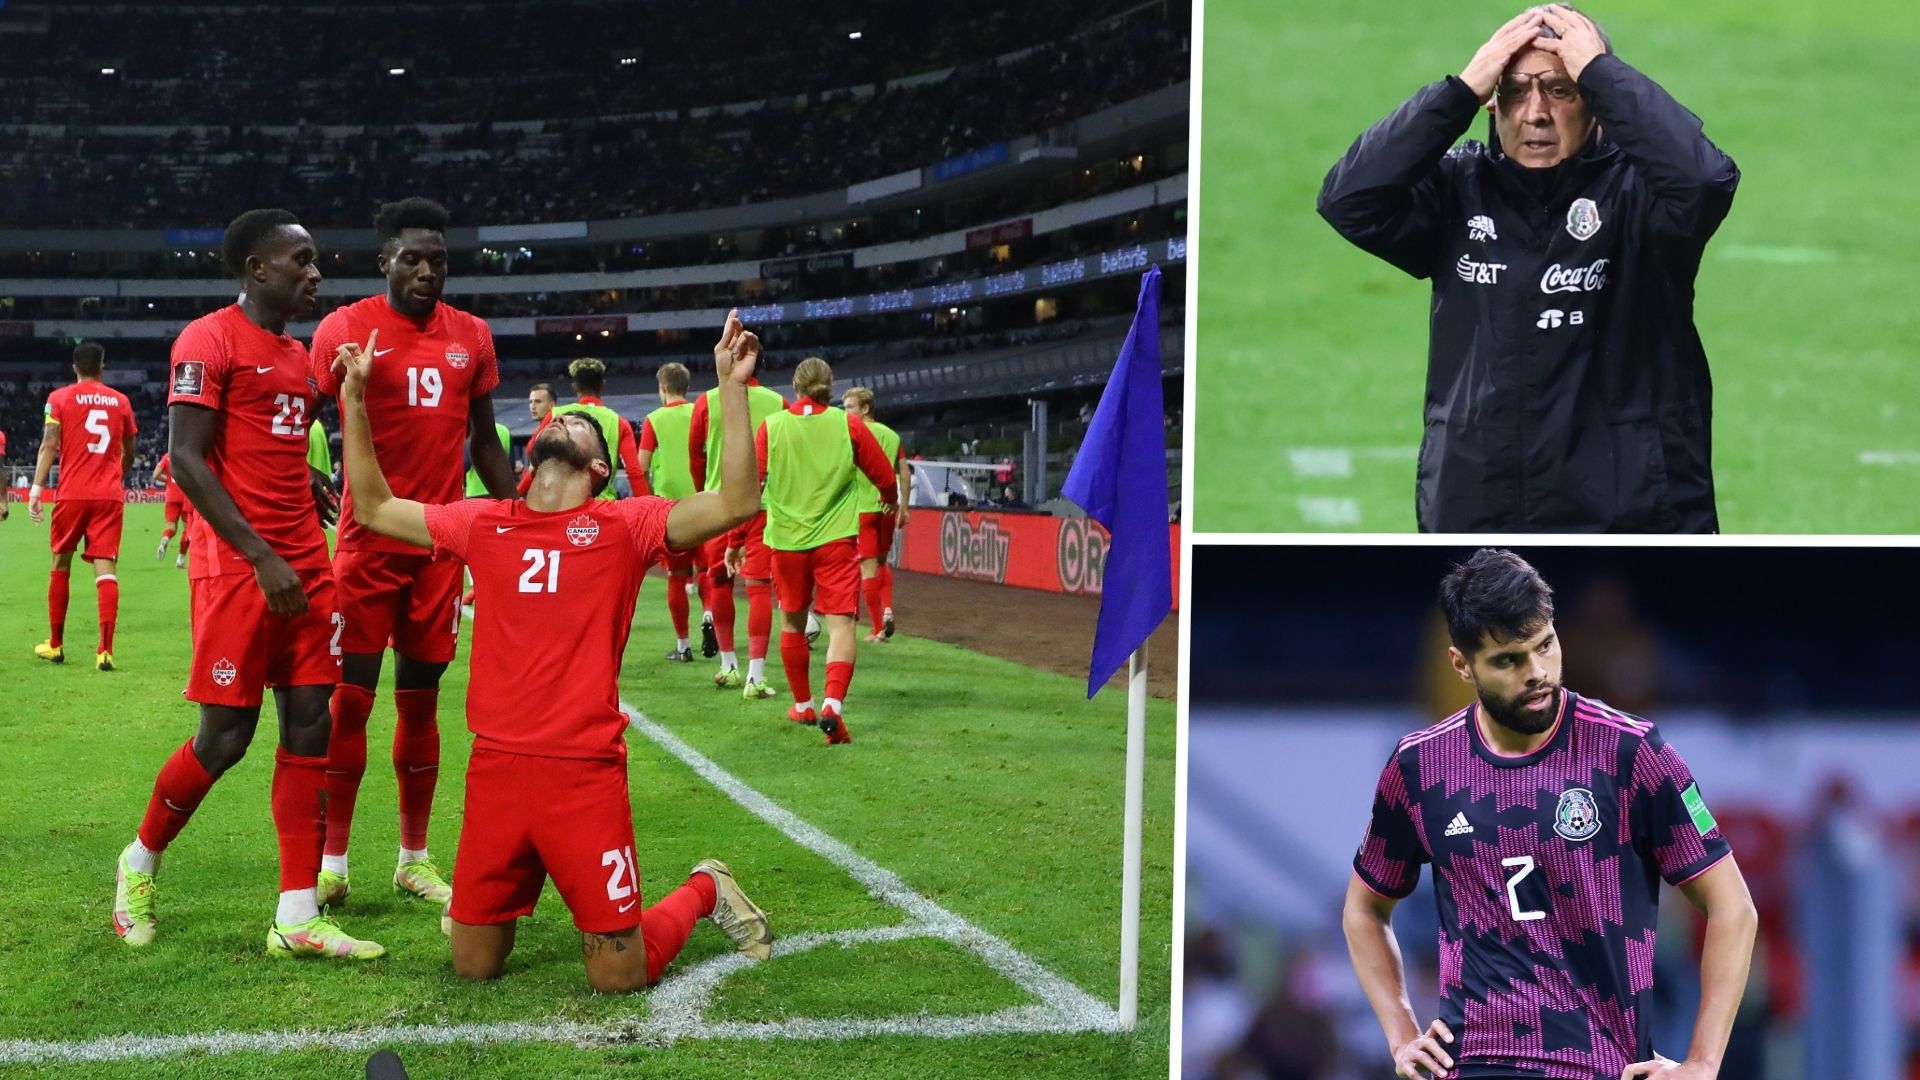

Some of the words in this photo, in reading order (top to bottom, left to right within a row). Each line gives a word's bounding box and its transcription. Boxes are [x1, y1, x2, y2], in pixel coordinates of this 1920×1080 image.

[407, 367, 443, 407] 19
[85, 409, 111, 454] 5
[271, 393, 305, 435] 22
[518, 549, 560, 593] 21
[1444, 824, 1474, 837] adidas
[601, 845, 638, 900] 21
[1501, 855, 1546, 921] 2
